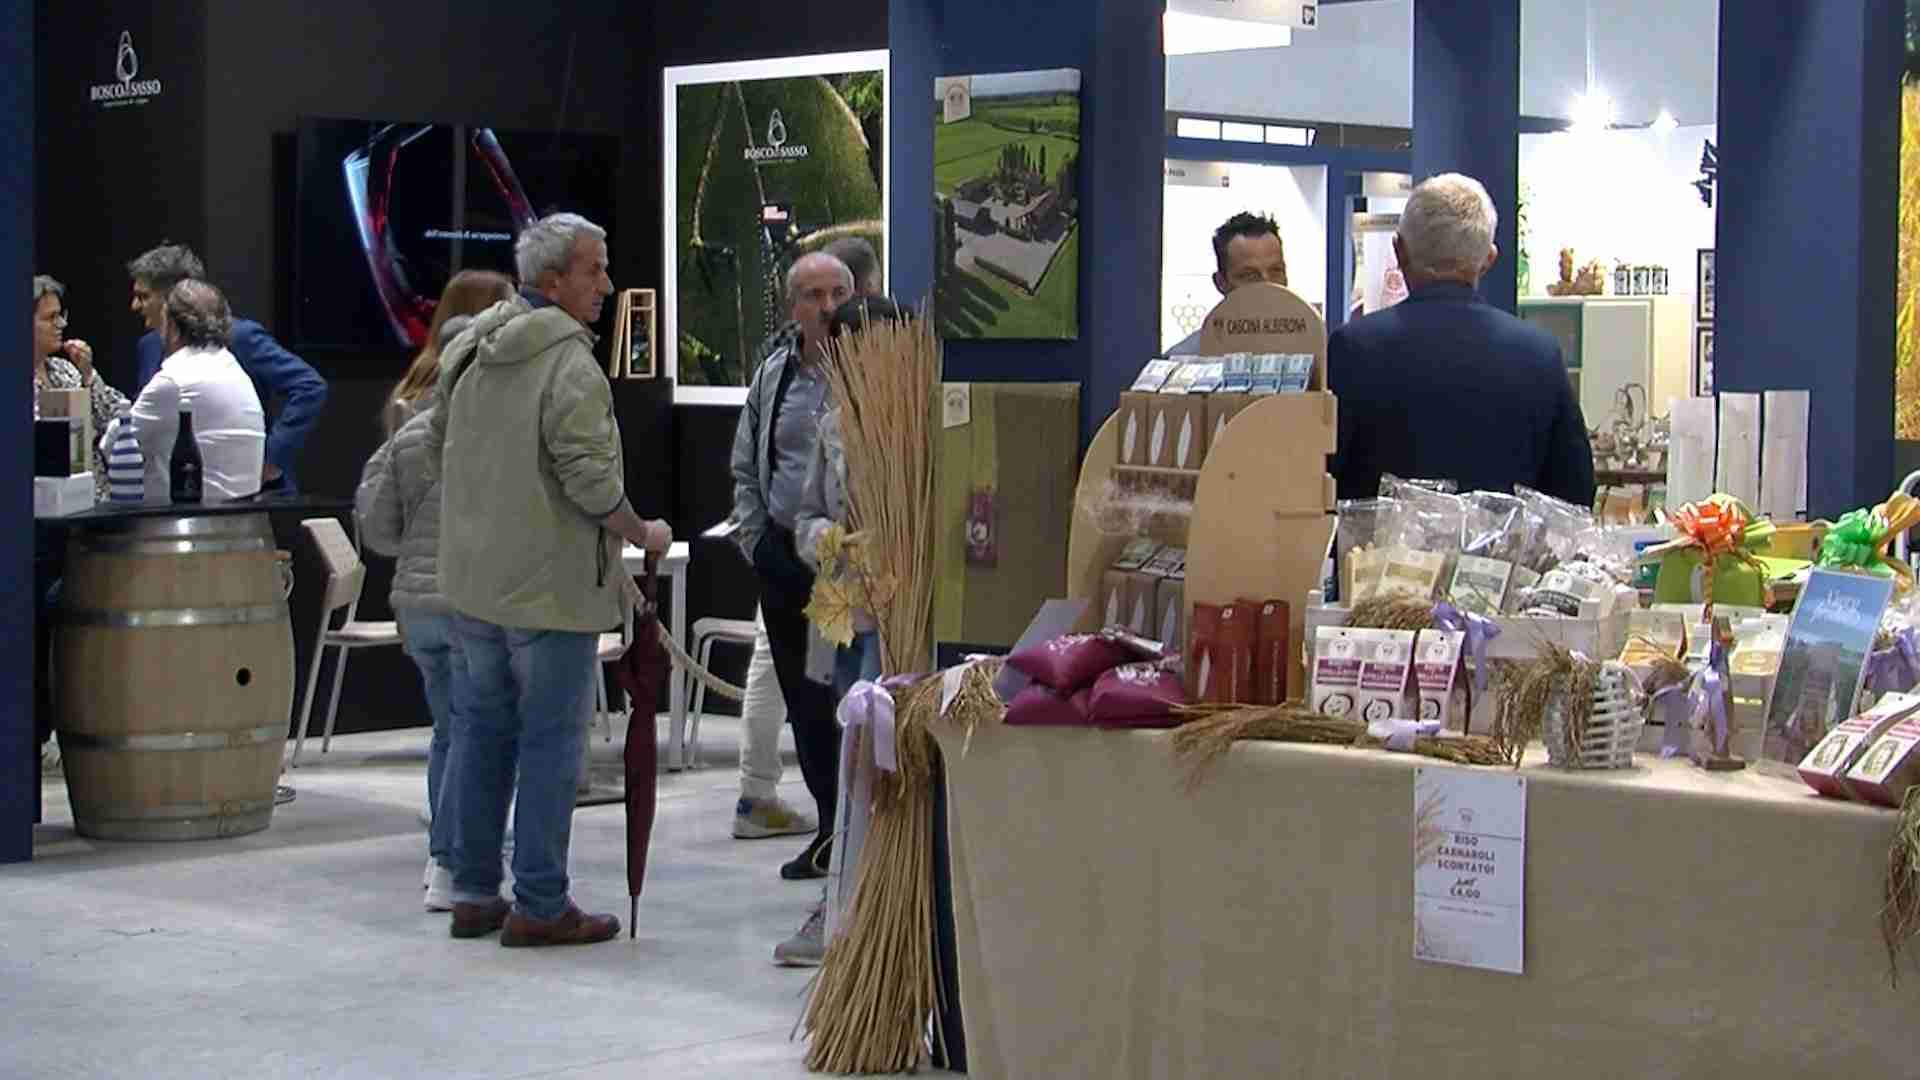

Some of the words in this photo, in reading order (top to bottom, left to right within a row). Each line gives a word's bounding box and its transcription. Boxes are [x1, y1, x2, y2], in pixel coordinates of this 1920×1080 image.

[1226, 319, 1260, 335] CASCINA
[1454, 834, 1479, 846] RISO
[1438, 847, 1496, 862] CARNAROLI
